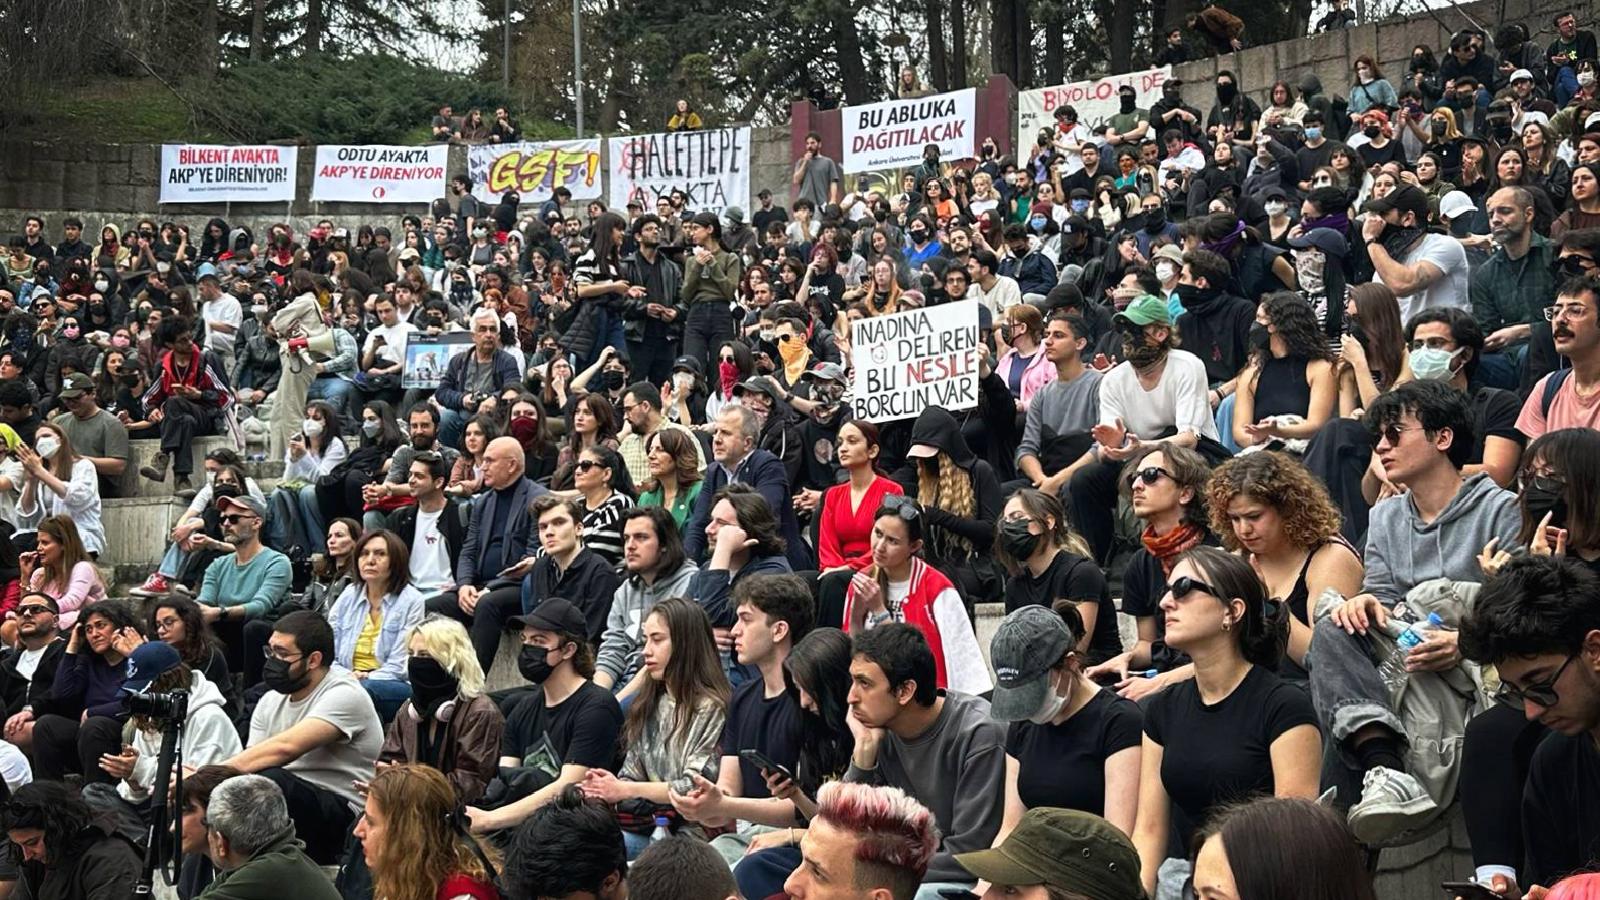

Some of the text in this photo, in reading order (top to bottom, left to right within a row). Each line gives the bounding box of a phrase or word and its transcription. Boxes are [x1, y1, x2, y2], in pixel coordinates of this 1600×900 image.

[1142, 72, 1165, 93] DE
[858, 99, 956, 130] BU ABLUKA
[852, 119, 966, 154] DAĞITILACAK
[180, 147, 279, 165] BİLKENT AYAKTA
[378, 150, 429, 163] AYAKTA
[168, 164, 288, 184] AKP'YE DİRENİYOR!
[319, 165, 443, 180] AKP'YE DİRENİYOR
[867, 365, 896, 394] BU
[855, 377, 975, 420] BORCUN VAR
